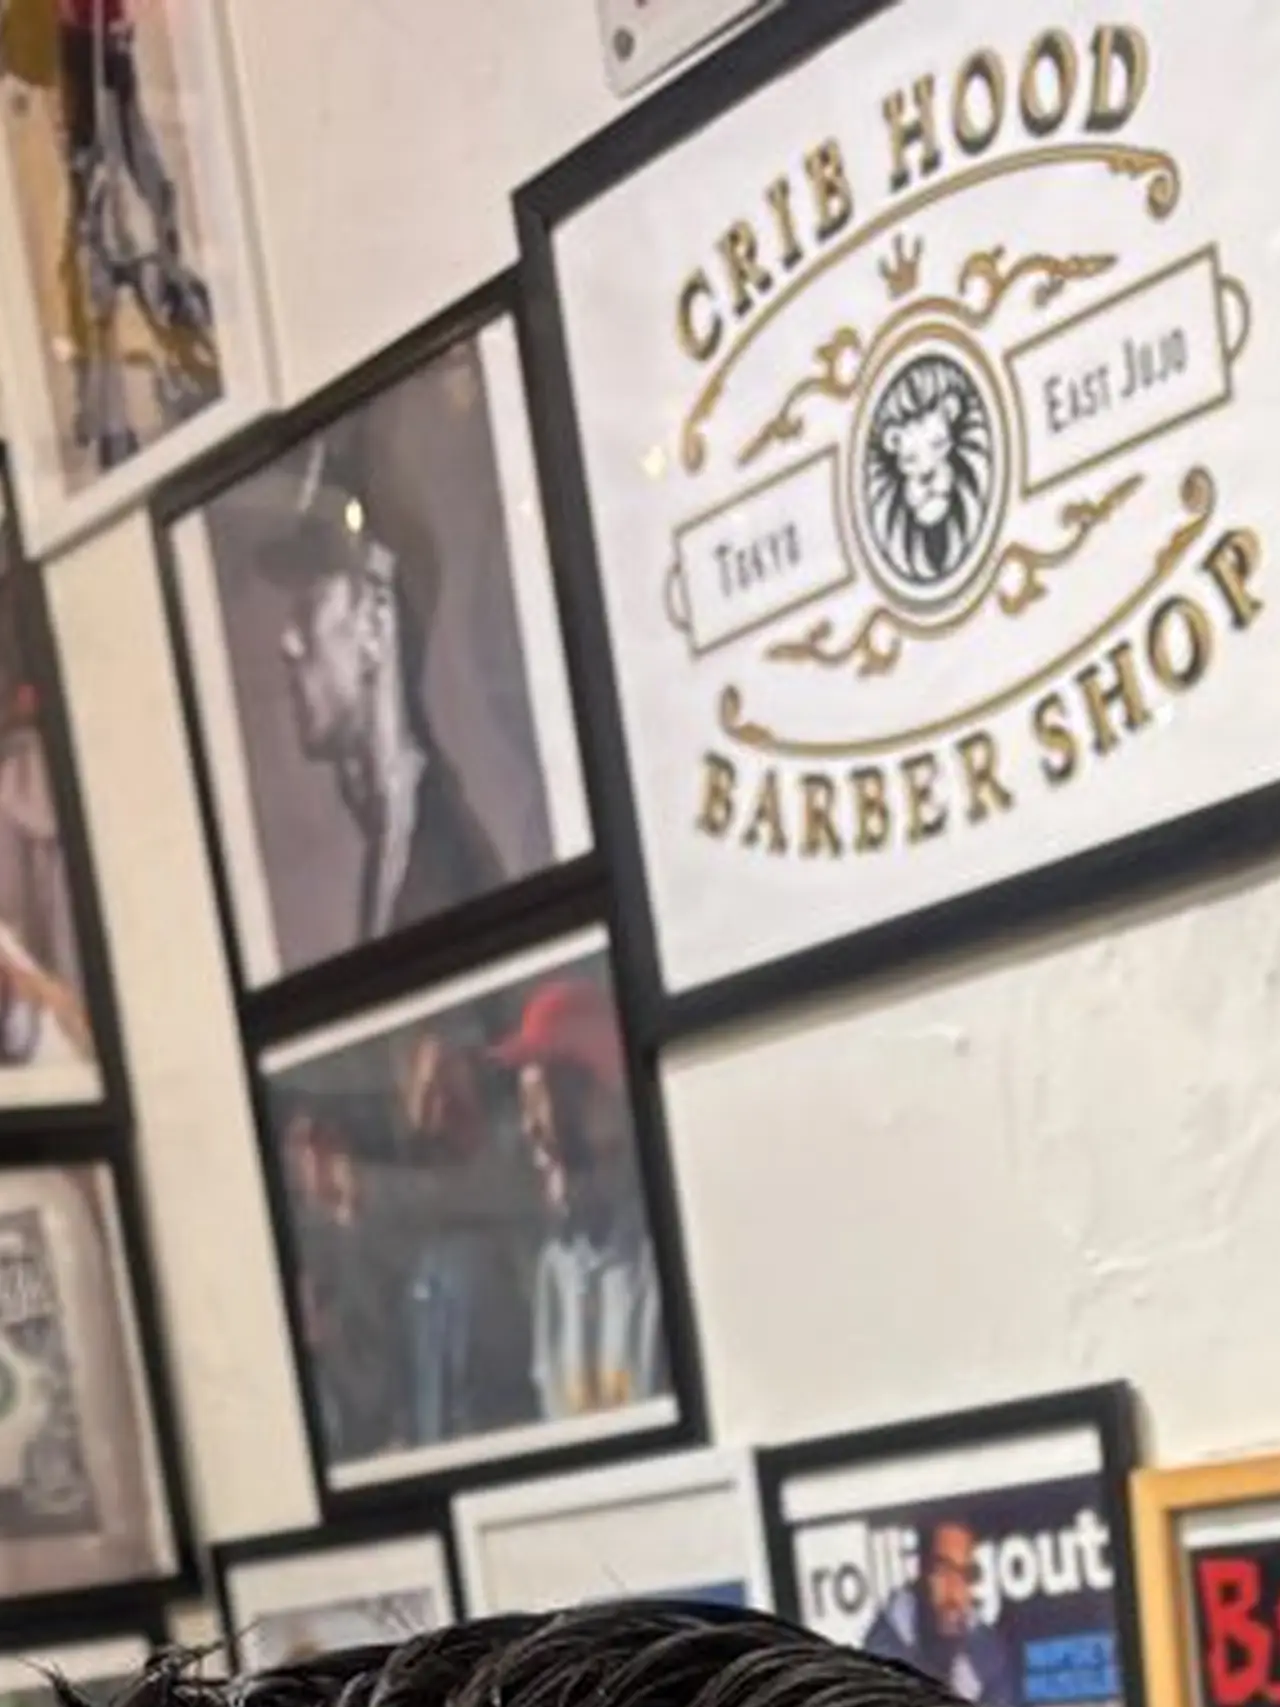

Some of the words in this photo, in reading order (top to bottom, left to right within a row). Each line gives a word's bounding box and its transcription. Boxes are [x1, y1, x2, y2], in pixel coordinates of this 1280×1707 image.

[675, 136, 854, 363] CRIB
[882, 23, 1150, 193] HOOD
[696, 729, 1014, 858] BARBER
[1032, 524, 1265, 787] SHOP
[811, 1508, 1114, 1627] rolligout
